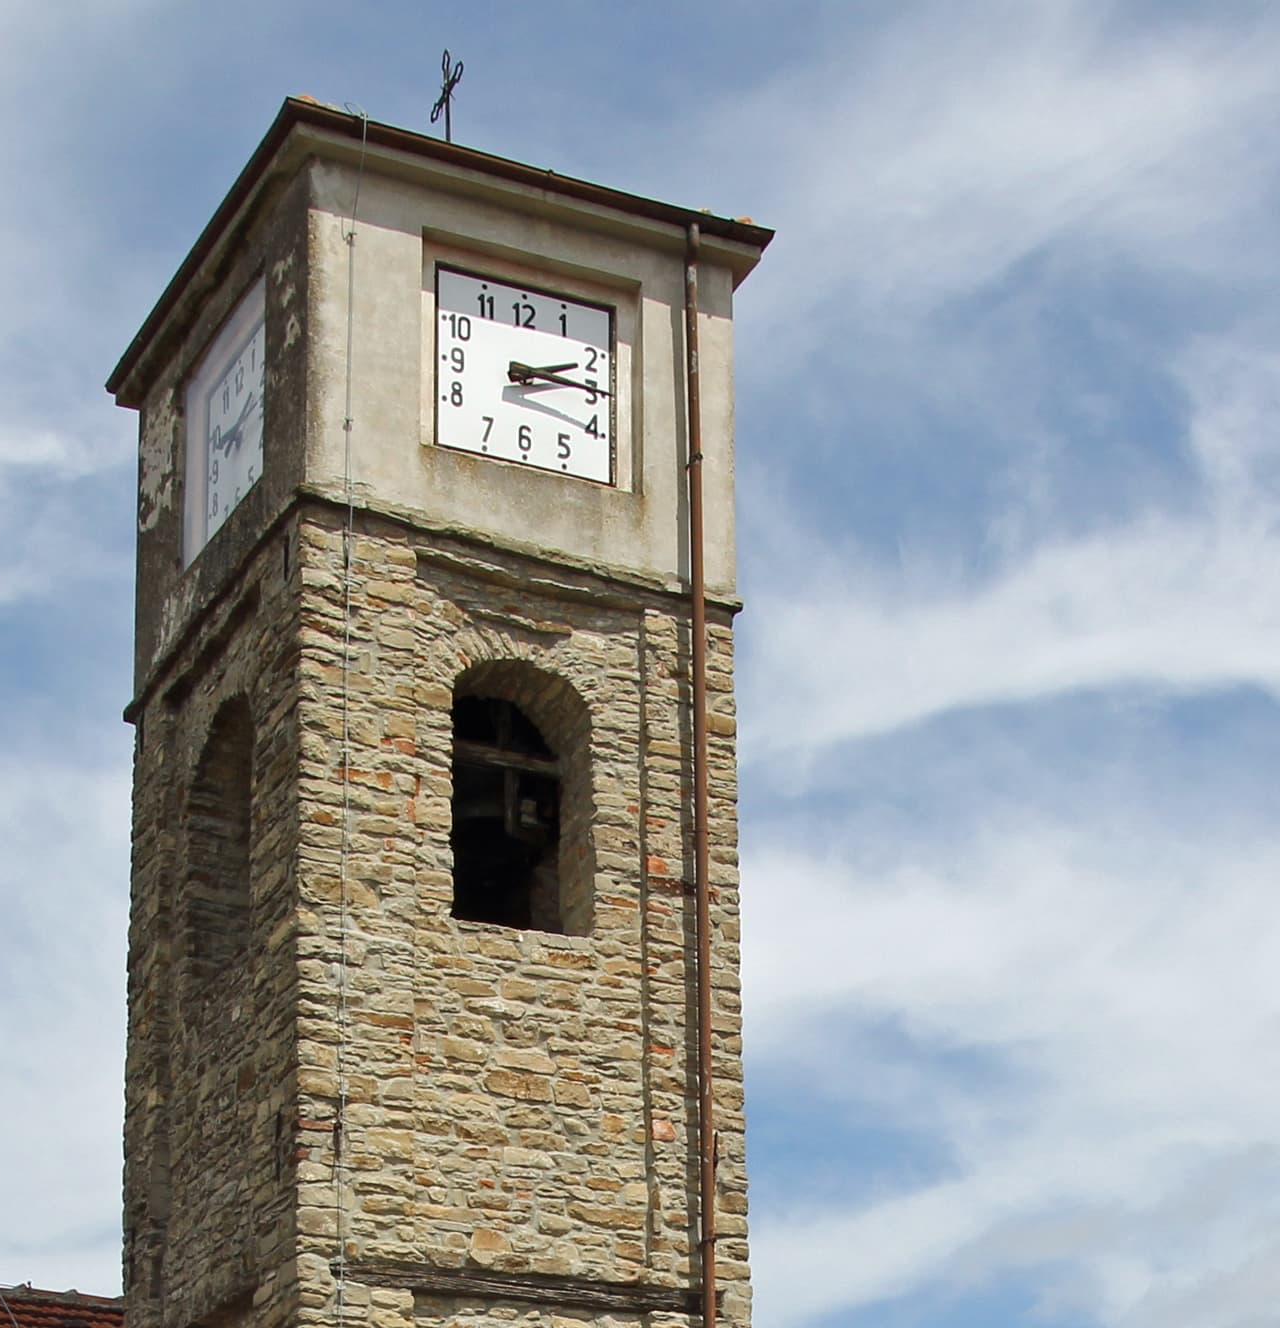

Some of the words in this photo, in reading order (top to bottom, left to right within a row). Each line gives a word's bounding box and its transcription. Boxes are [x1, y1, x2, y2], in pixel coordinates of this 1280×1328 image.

[477, 293, 494, 320] 11
[512, 302, 536, 329] 12
[449, 313, 471, 341] 10
[558, 313, 567, 337] 1
[451, 347, 465, 373] 9
[584, 347, 598, 372] 2
[450, 381, 464, 407] 8
[584, 379, 598, 405] 3
[482, 416, 494, 443] 7
[518, 425, 532, 451] 6
[584, 415, 598, 440] 4
[557, 433, 571, 460] 5
